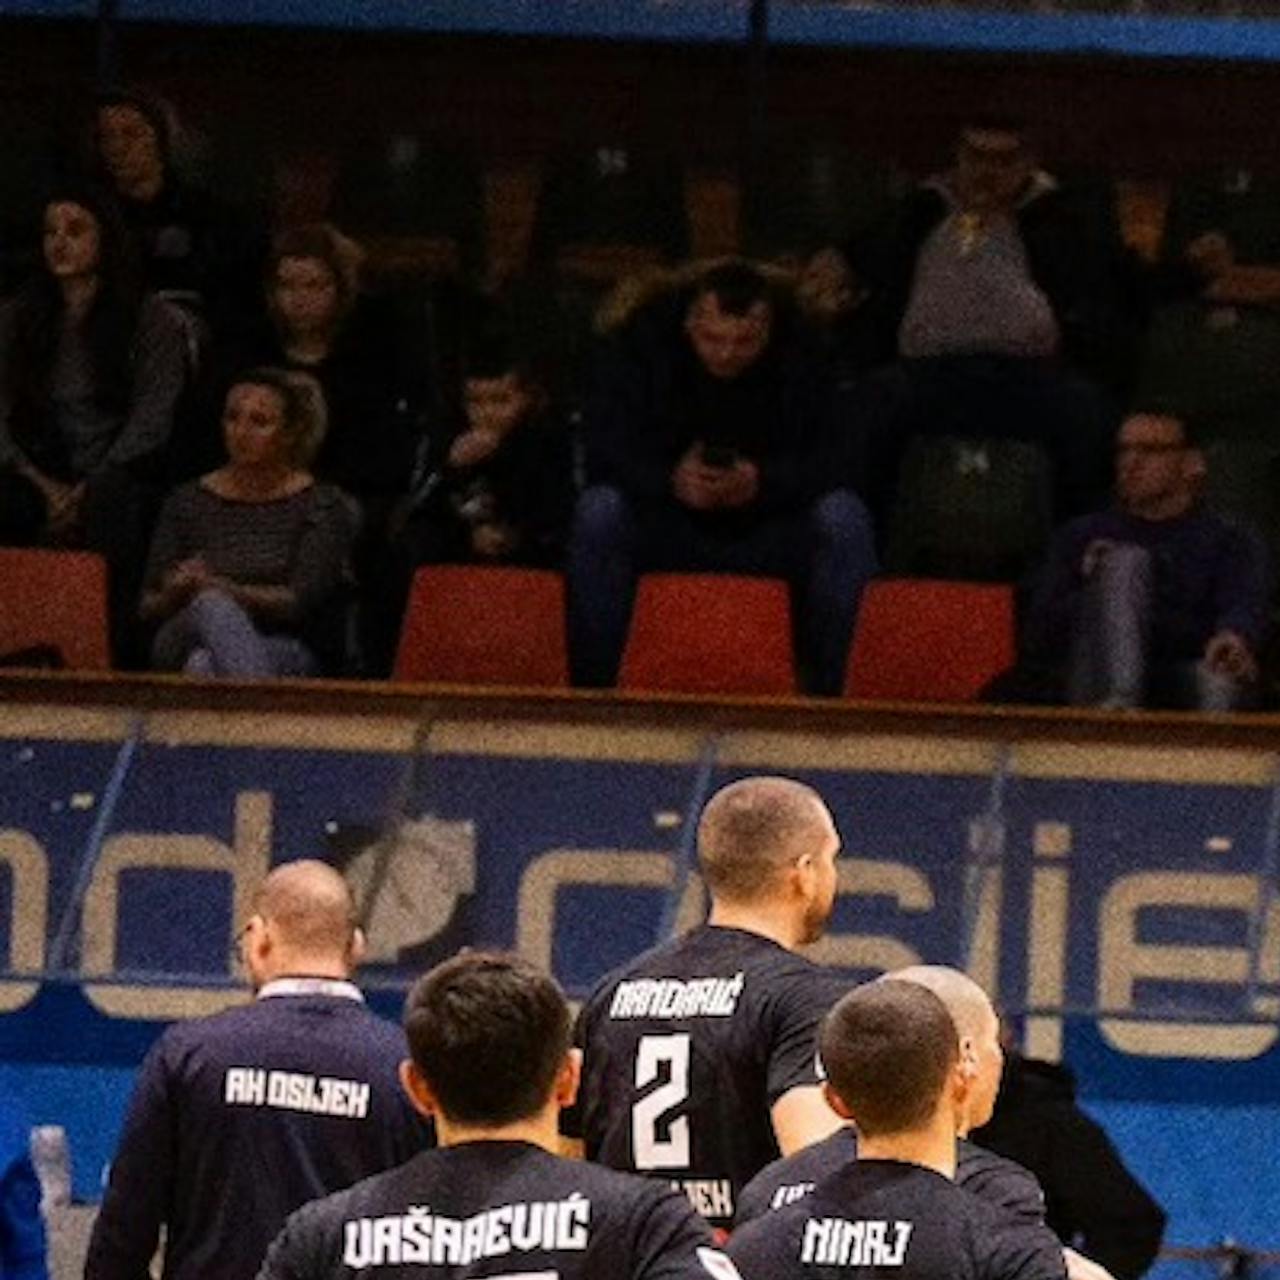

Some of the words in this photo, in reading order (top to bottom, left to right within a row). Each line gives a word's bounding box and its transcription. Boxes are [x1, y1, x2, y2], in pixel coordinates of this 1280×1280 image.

[225, 1067, 265, 1105] RK
[267, 1070, 370, 1118] OSIJEK
[632, 1034, 690, 1170] 2
